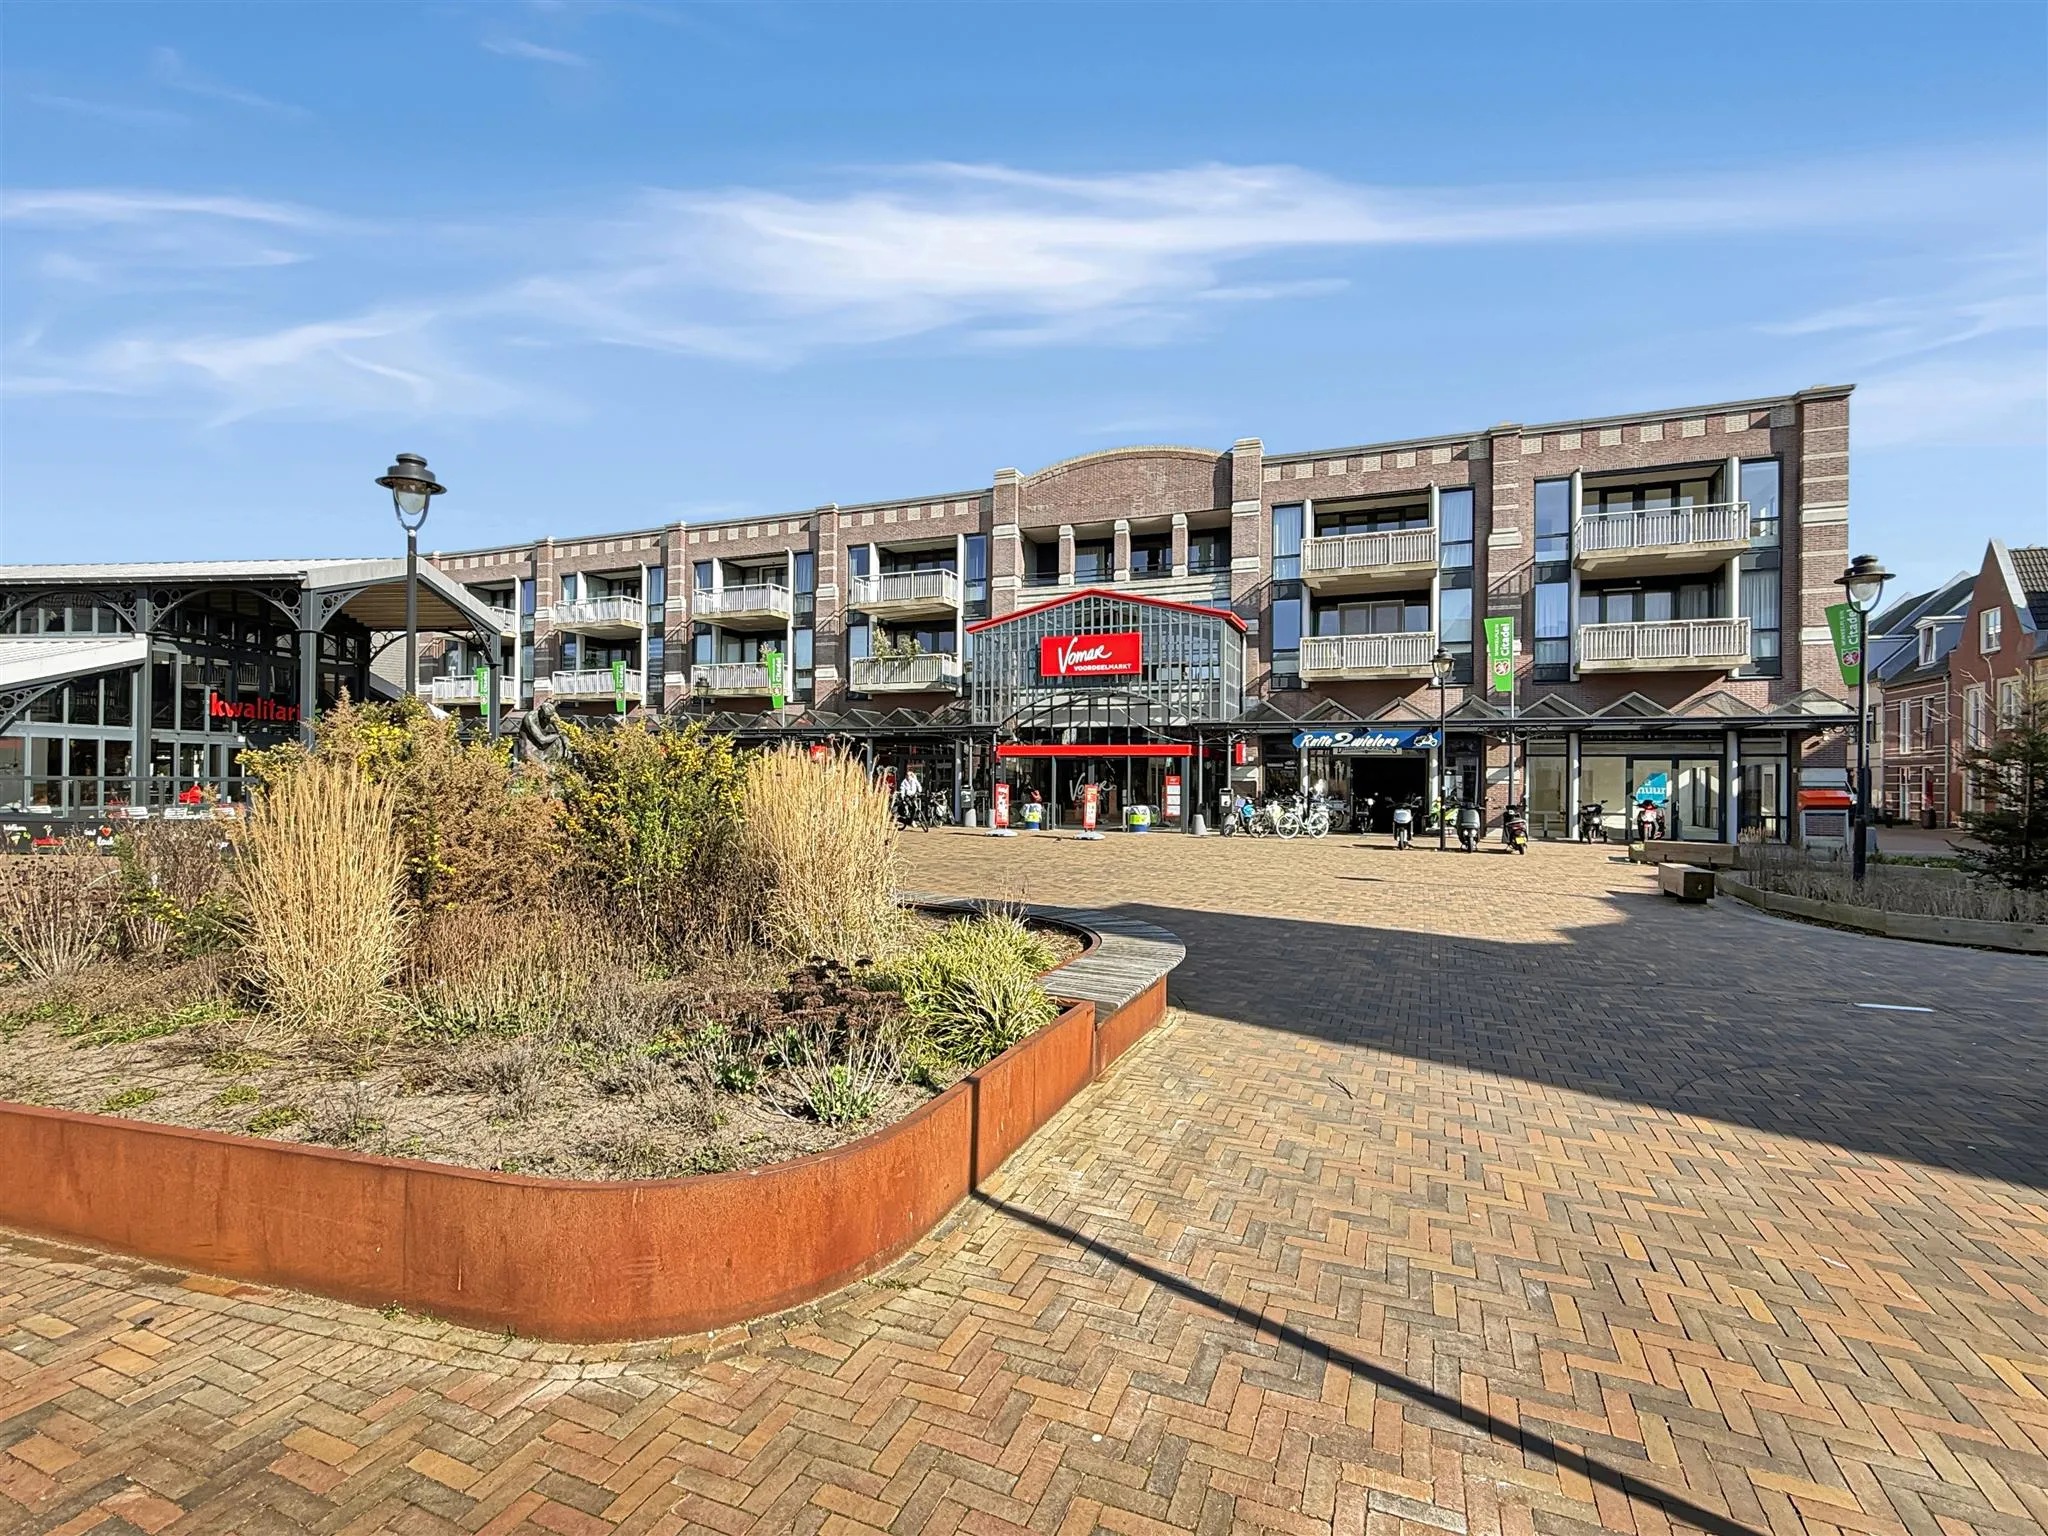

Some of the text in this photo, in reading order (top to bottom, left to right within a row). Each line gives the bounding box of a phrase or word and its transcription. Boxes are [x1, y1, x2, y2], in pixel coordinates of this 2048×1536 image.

[1500, 623, 1510, 656] Citadel
[1846, 608, 1858, 645] Citadel
[1057, 636, 1112, 674] Vomar
[1073, 663, 1132, 672] VOORDEELMARKT
[210, 692, 301, 721] kwalitari
[1069, 772, 1117, 802] Vor
